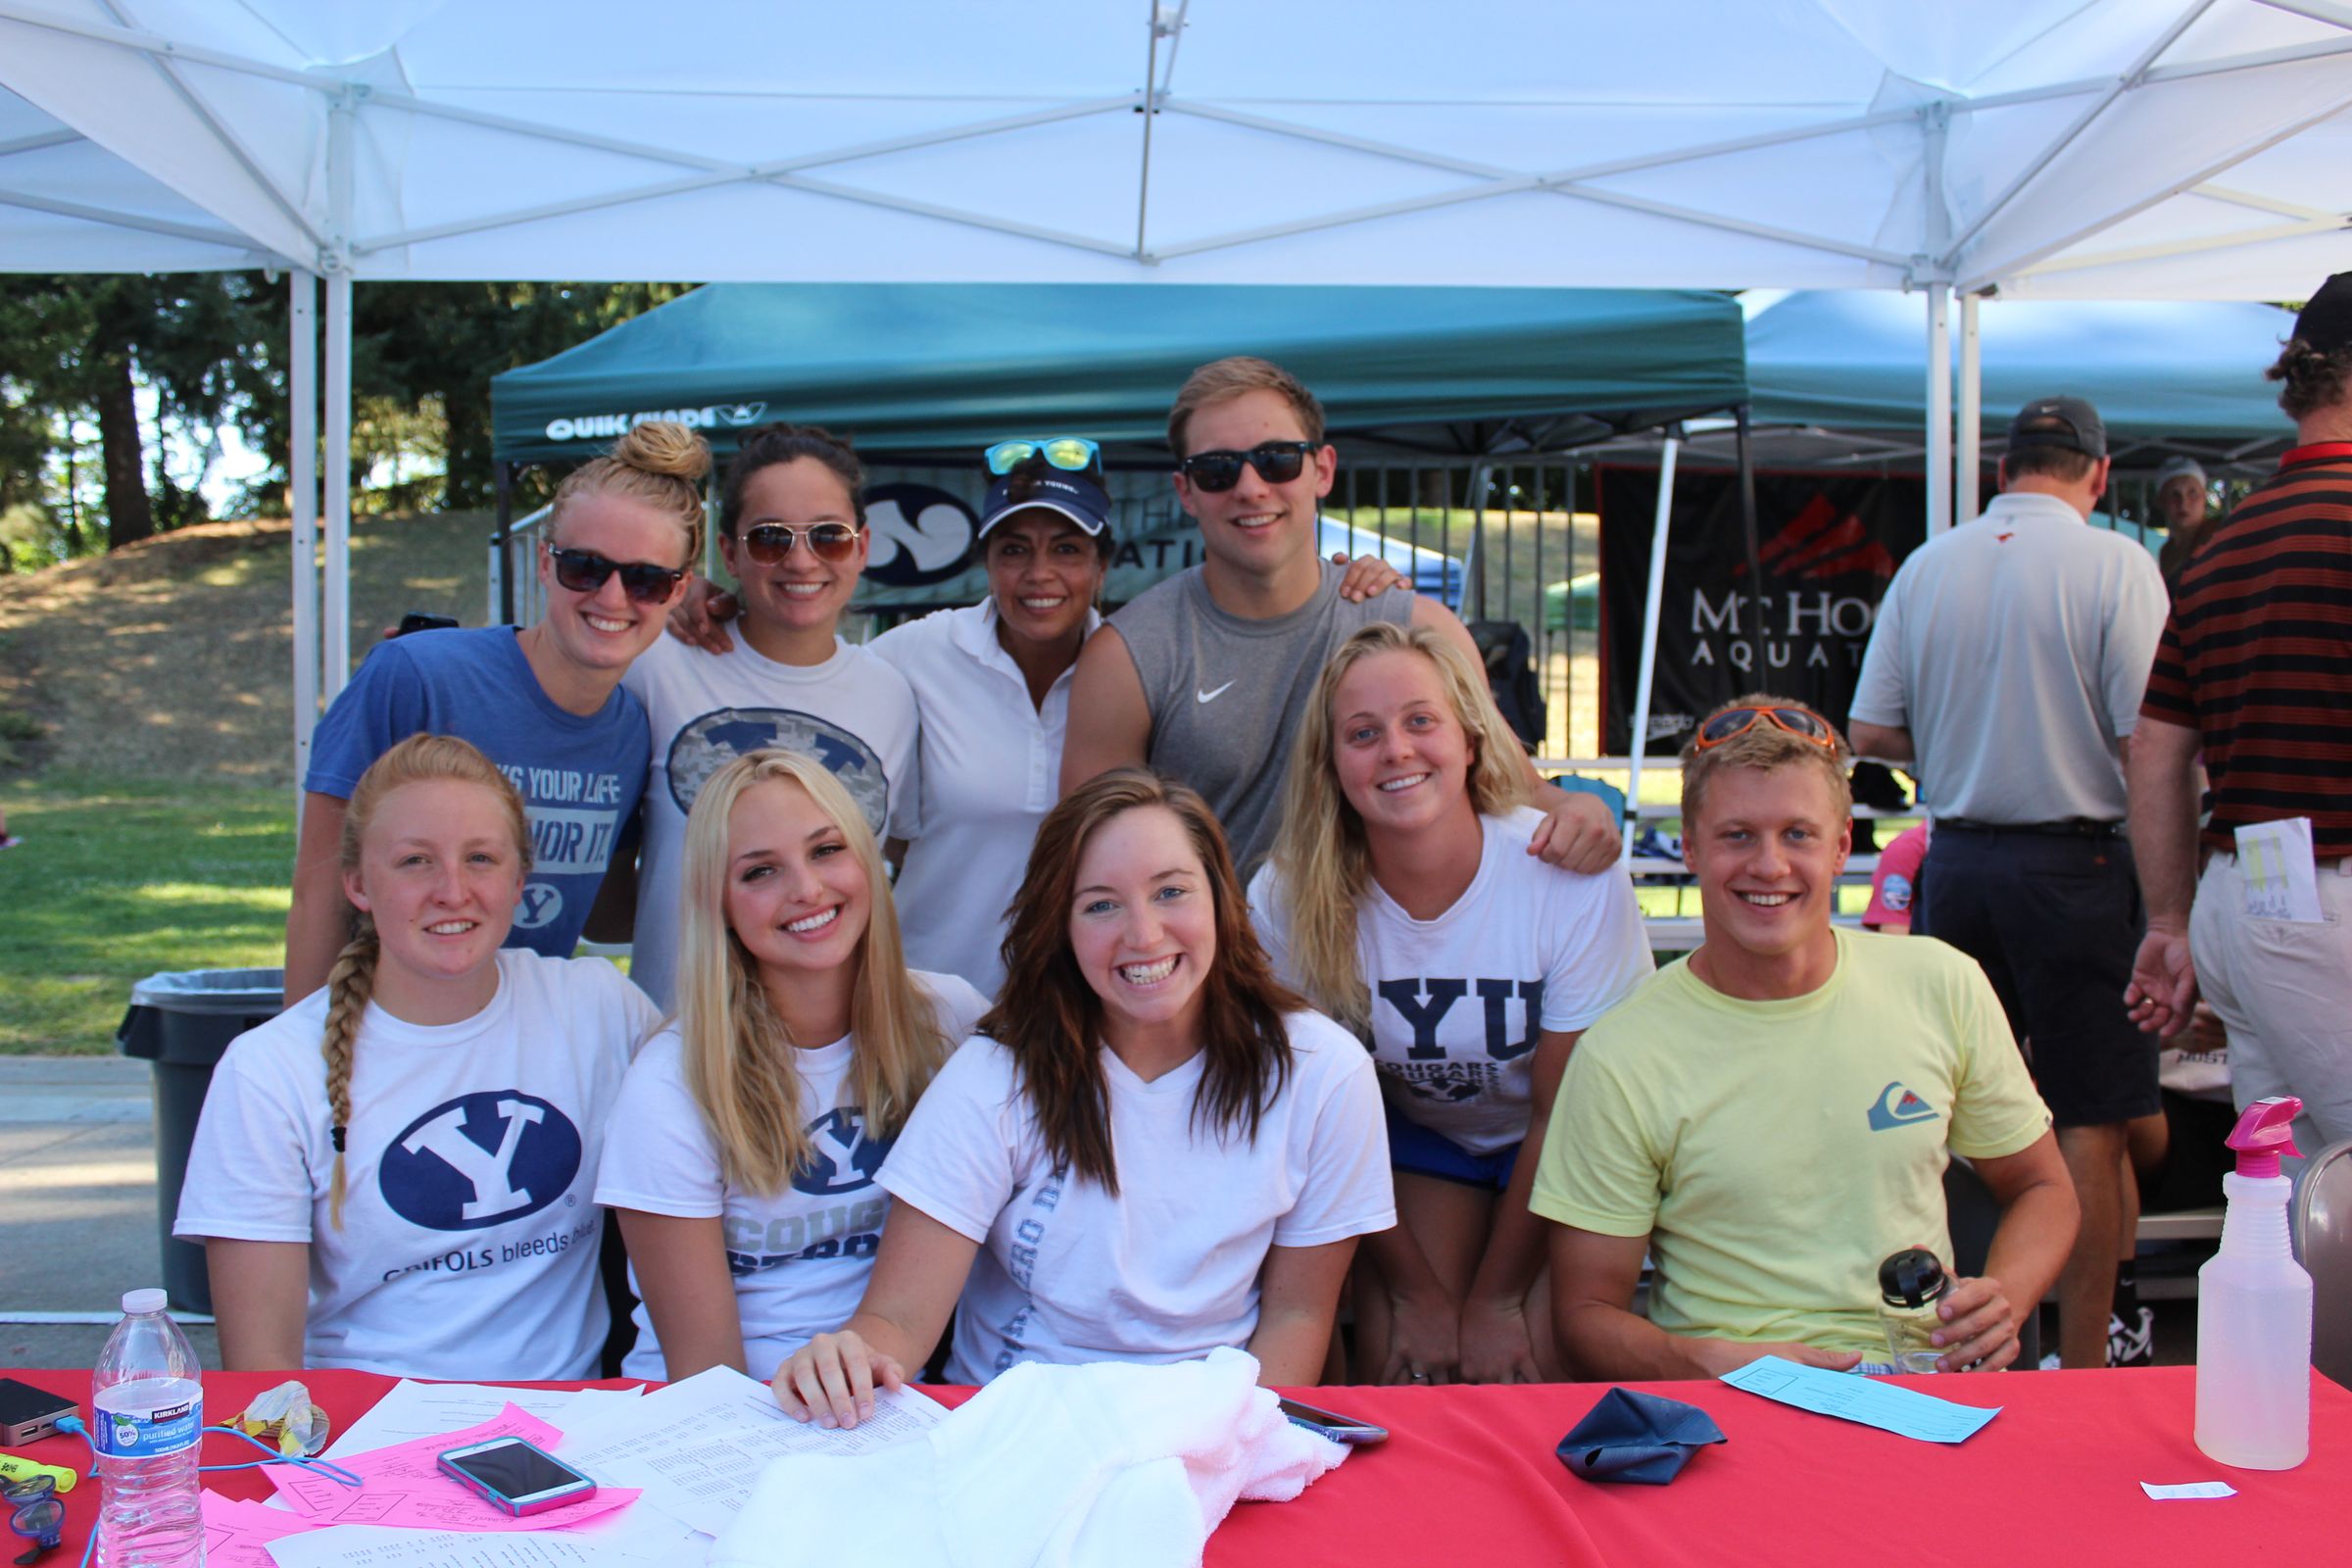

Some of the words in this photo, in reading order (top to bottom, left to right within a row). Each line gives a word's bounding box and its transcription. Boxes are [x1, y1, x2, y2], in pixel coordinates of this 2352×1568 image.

[1113, 538, 1207, 568] ATI
[1787, 590, 1881, 637] HO
[527, 766, 582, 802] YOUR
[582, 772, 620, 804] LIFE
[1366, 978, 1544, 1061] YU
[401, 1099, 546, 1220] Y
[502, 1232, 568, 1263] bleeds
[153, 1404, 189, 1419] KIRKLAND
[119, 1430, 136, 1440] 50%
[143, 1426, 176, 1443] purified
